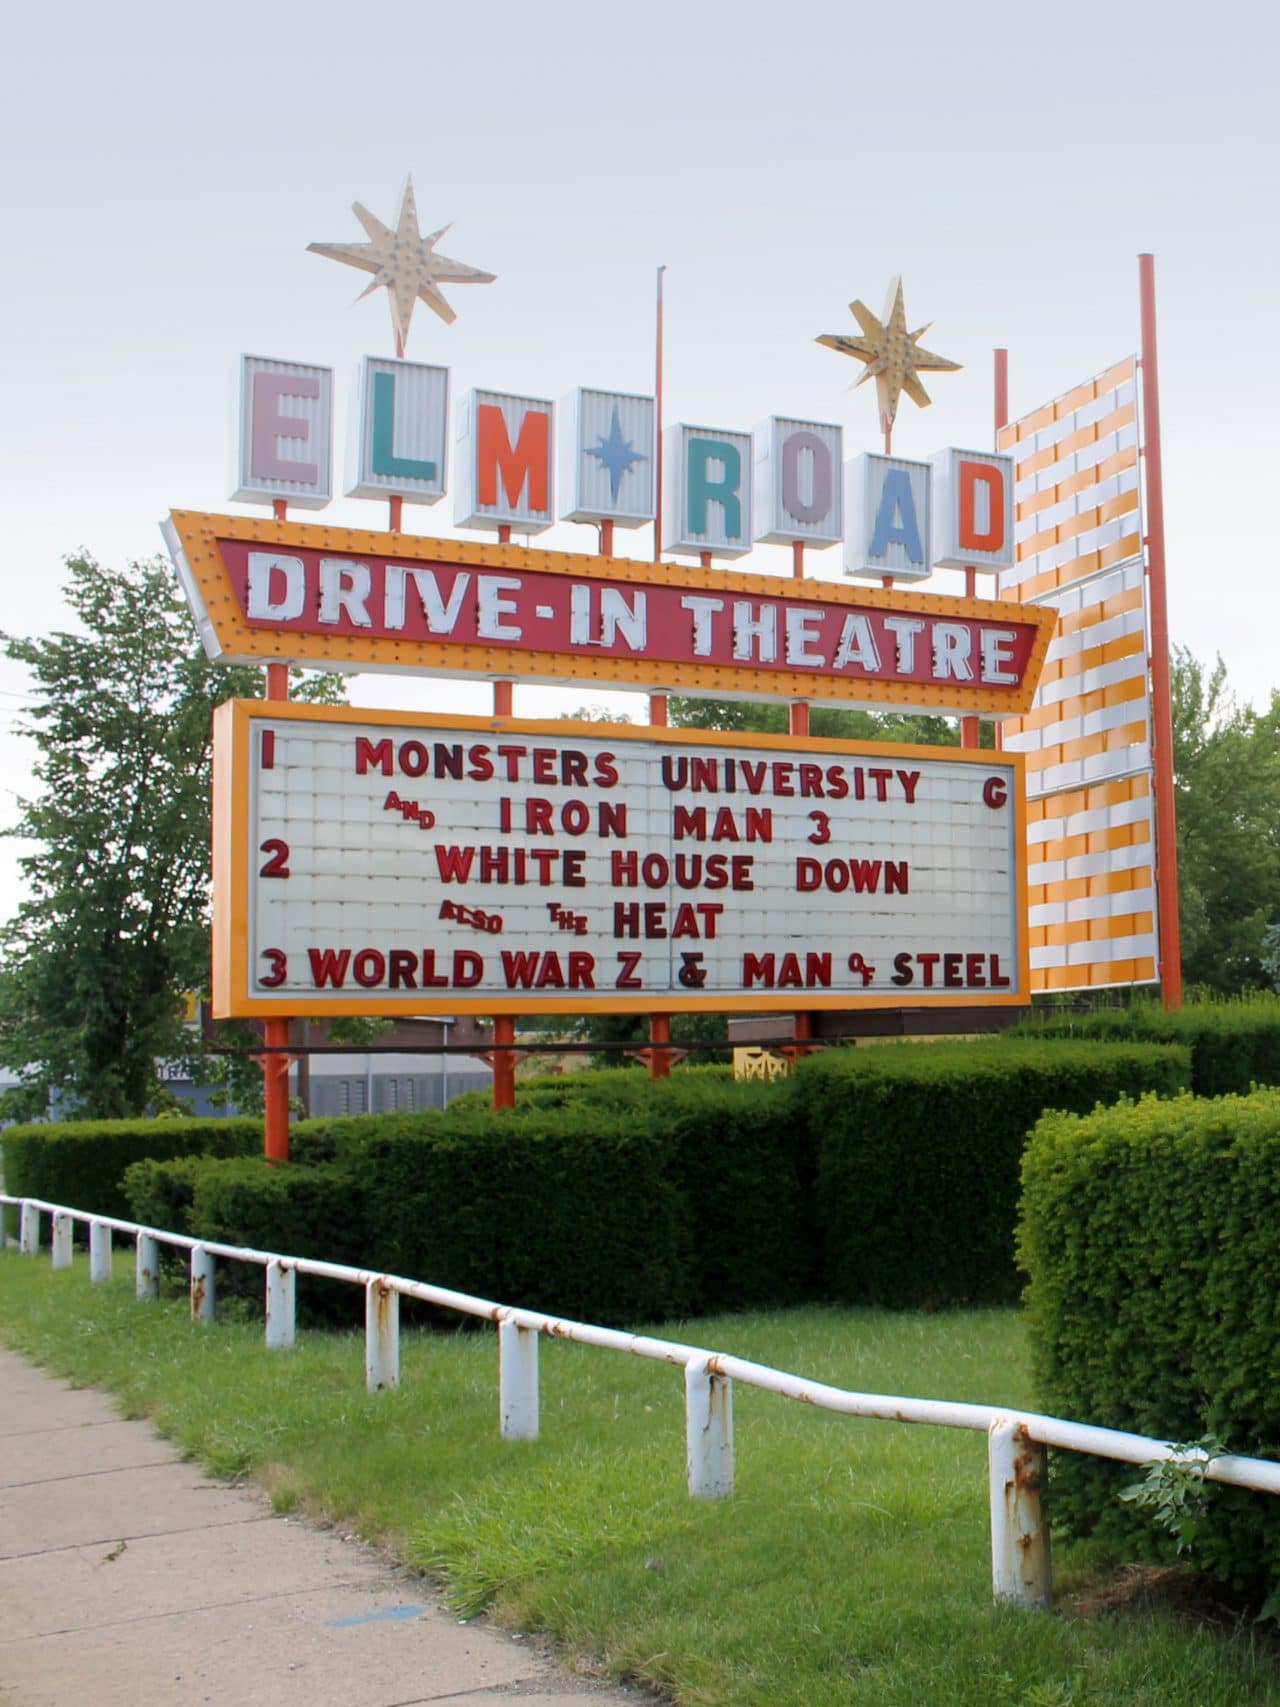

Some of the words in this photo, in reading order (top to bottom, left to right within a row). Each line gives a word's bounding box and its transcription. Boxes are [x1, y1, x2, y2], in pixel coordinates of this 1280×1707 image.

[252, 372, 548, 511] ELM
[688, 432, 1005, 565] ROAD
[247, 552, 646, 651] DRIVE-IN
[681, 595, 1018, 686] THEATRE
[262, 730, 274, 769] 1
[356, 737, 619, 788] MONSTERS
[662, 755, 920, 803] UNIVERSITY
[983, 777, 1007, 809] G
[384, 791, 435, 829] AND
[500, 797, 627, 838] IRON
[674, 806, 772, 842] MAN
[808, 810, 831, 845] 3
[260, 839, 290, 878] 2
[434, 845, 586, 887] WHITE
[611, 850, 754, 890] HOUSE
[796, 857, 908, 894] DOWN
[438, 899, 503, 934] ALSO
[546, 902, 588, 935] THE
[614, 902, 723, 938] HEAT
[258, 948, 287, 987] 3
[308, 948, 484, 988] WORLD
[501, 951, 595, 988] WAR
[616, 951, 642, 988] Z
[678, 952, 707, 988] &
[743, 952, 832, 987] MAN
[848, 953, 876, 987] OF
[891, 952, 1010, 987] STEEL
